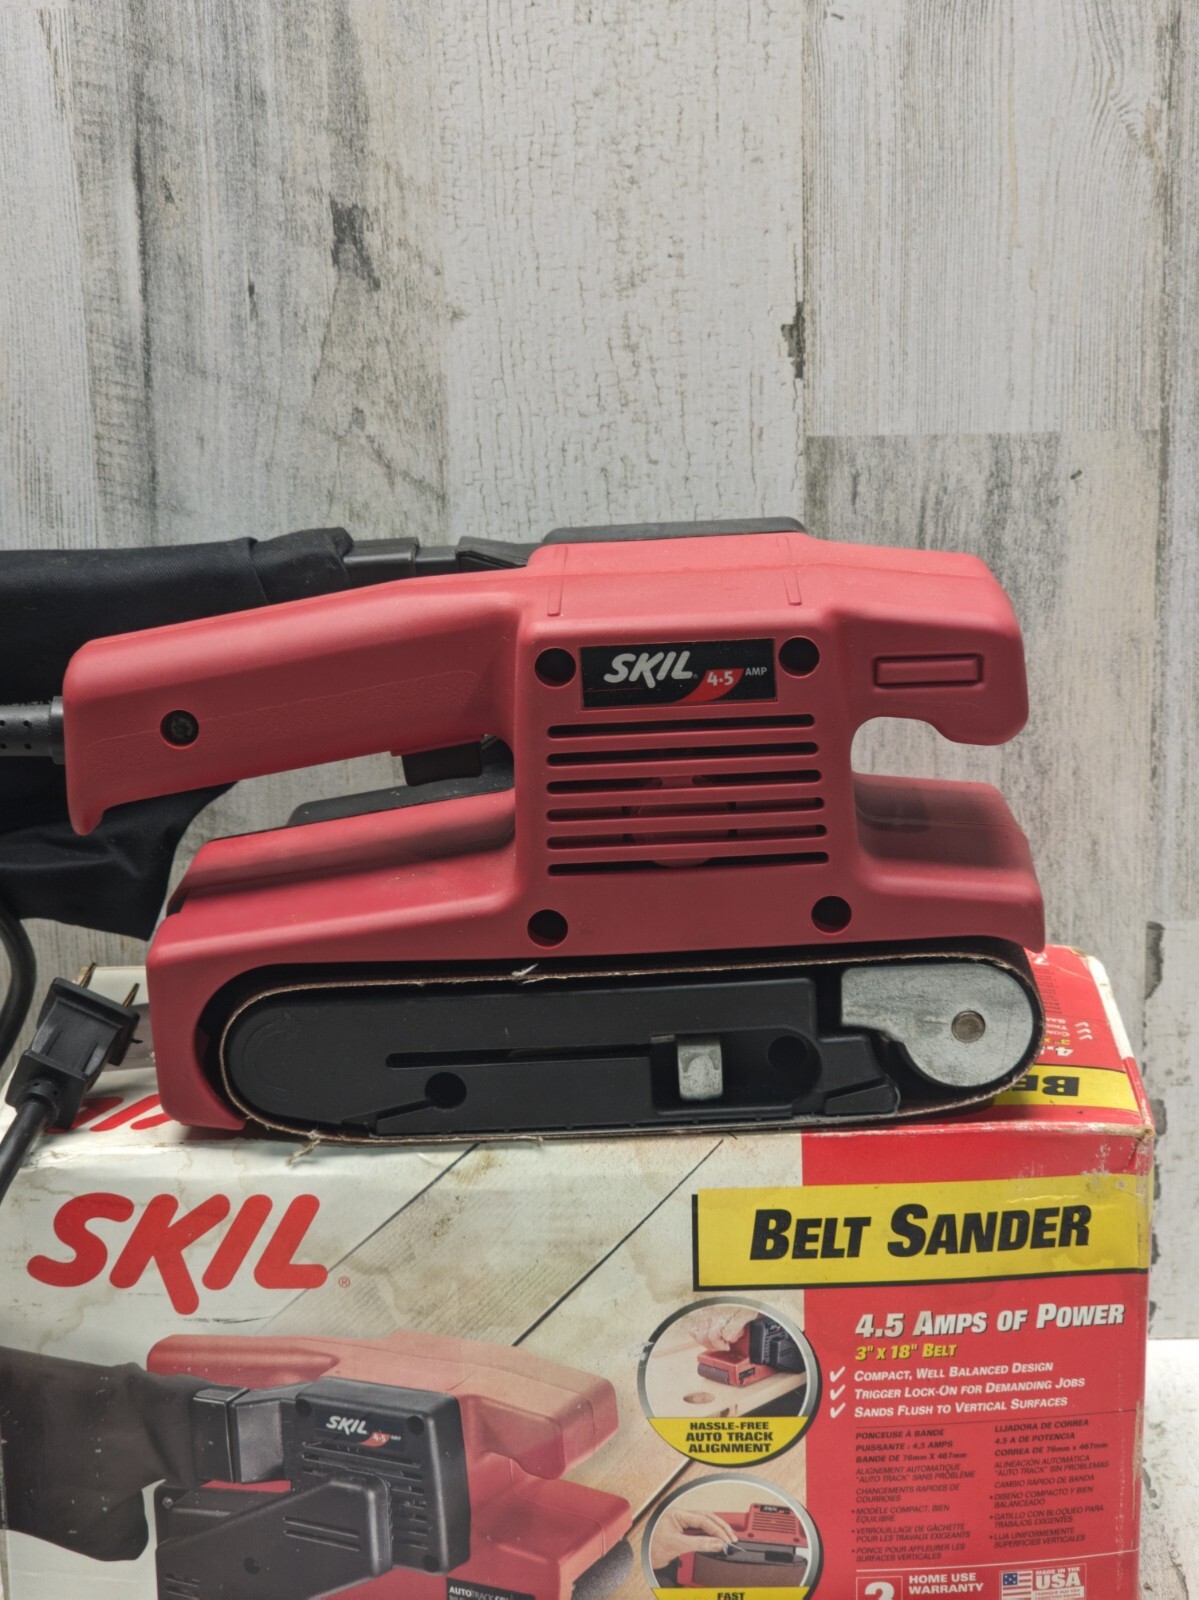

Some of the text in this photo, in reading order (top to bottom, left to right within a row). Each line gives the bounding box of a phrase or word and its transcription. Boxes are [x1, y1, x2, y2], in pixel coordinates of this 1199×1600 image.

[745, 667, 767, 676] AMP
[749, 1203, 1092, 1261] BELT SANDER
[855, 1303, 1125, 1338] 4.5 AMPS OF POWER
[855, 1345, 874, 1360] 3"
[891, 1344, 918, 1359] 18"
[922, 1343, 957, 1358] BELT
[854, 1362, 1054, 1382] COMPACT, WELL BALANCED DESIGN
[854, 1377, 1085, 1400] TRIGGER LOCK-ON FOR DEMANDING JOBS
[854, 1397, 1068, 1418] SANDS FLUSH TO VERTICAL SURFACES
[326, 1415, 368, 1436] SKIL
[689, 1421, 770, 1431] HASSLE-FREE
[994, 1419, 1089, 1433] LIJADORA DE CORREA
[685, 1431, 774, 1442] AUTO TRACK
[856, 1431, 903, 1440] PONCEUSE
[914, 1428, 944, 1437] BANDE
[994, 1432, 1076, 1445] 4.5 A DE POTENCIA
[688, 1443, 772, 1454] ALIGNMENT
[856, 1443, 905, 1452] PUISSANTE
[912, 1441, 926, 1450] 4.5
[927, 1440, 953, 1449] AMPS
[994, 1448, 1030, 1457] CORREA
[1032, 1447, 1044, 1455] DE
[856, 1454, 886, 1463] BANDE
[888, 1454, 900, 1462] DE
[1057, 1476, 1067, 1484] DE
[949, 1483, 960, 1491] DE
[1025, 1488, 1068, 1498] COMPACTO
[1069, 1487, 1076, 1495] Y
[1076, 1486, 1094, 1494] BIEN
[932, 1504, 950, 1512] BIEN
[1027, 1509, 1045, 1518] CON
[914, 1524, 925, 1532] DE
[908, 1572, 977, 1584] HOME USE
[1035, 1571, 1081, 1590] USA
[908, 1582, 984, 1595] WARRANTY
[717, 1592, 745, 1600] FAST
